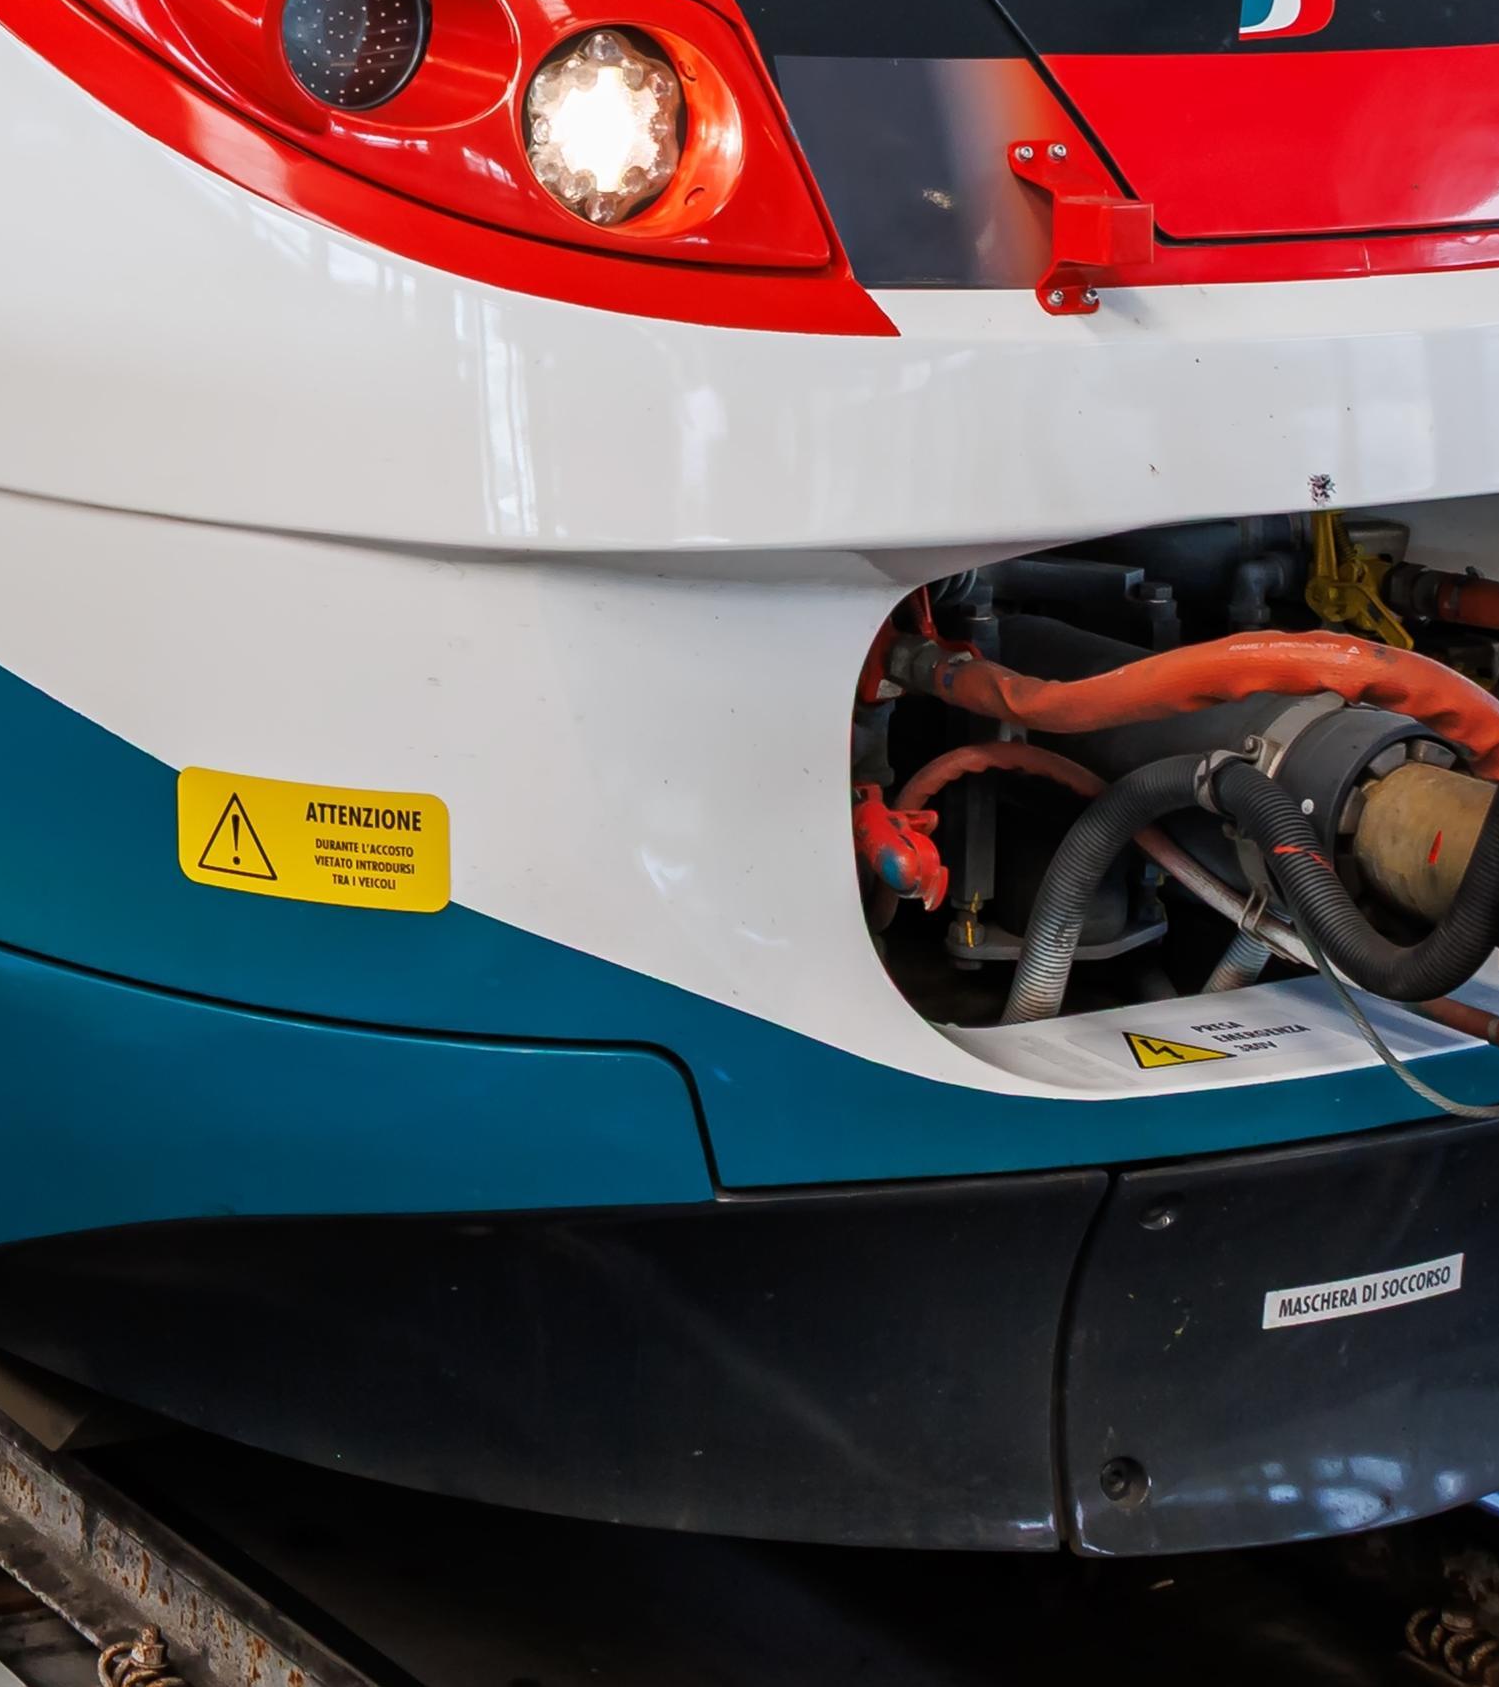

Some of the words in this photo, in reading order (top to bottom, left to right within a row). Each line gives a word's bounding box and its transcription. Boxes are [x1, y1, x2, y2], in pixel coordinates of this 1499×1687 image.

[305, 801, 422, 832] ATTENZIONE
[315, 838, 359, 853] DURANTE
[361, 843, 414, 858] L'ACCOSTO
[314, 855, 353, 870] VIETATO
[355, 859, 415, 875] INTRODURSI
[332, 873, 350, 886] TRA
[358, 877, 397, 890] VEICOLI
[1190, 1020, 1245, 1034] PRESA
[1212, 1023, 1312, 1043] EMERGENZA
[1278, 1286, 1357, 1318] MASCHERA
[1362, 1283, 1377, 1304] DI
[1381, 1265, 1451, 1300] SOCCORSO
